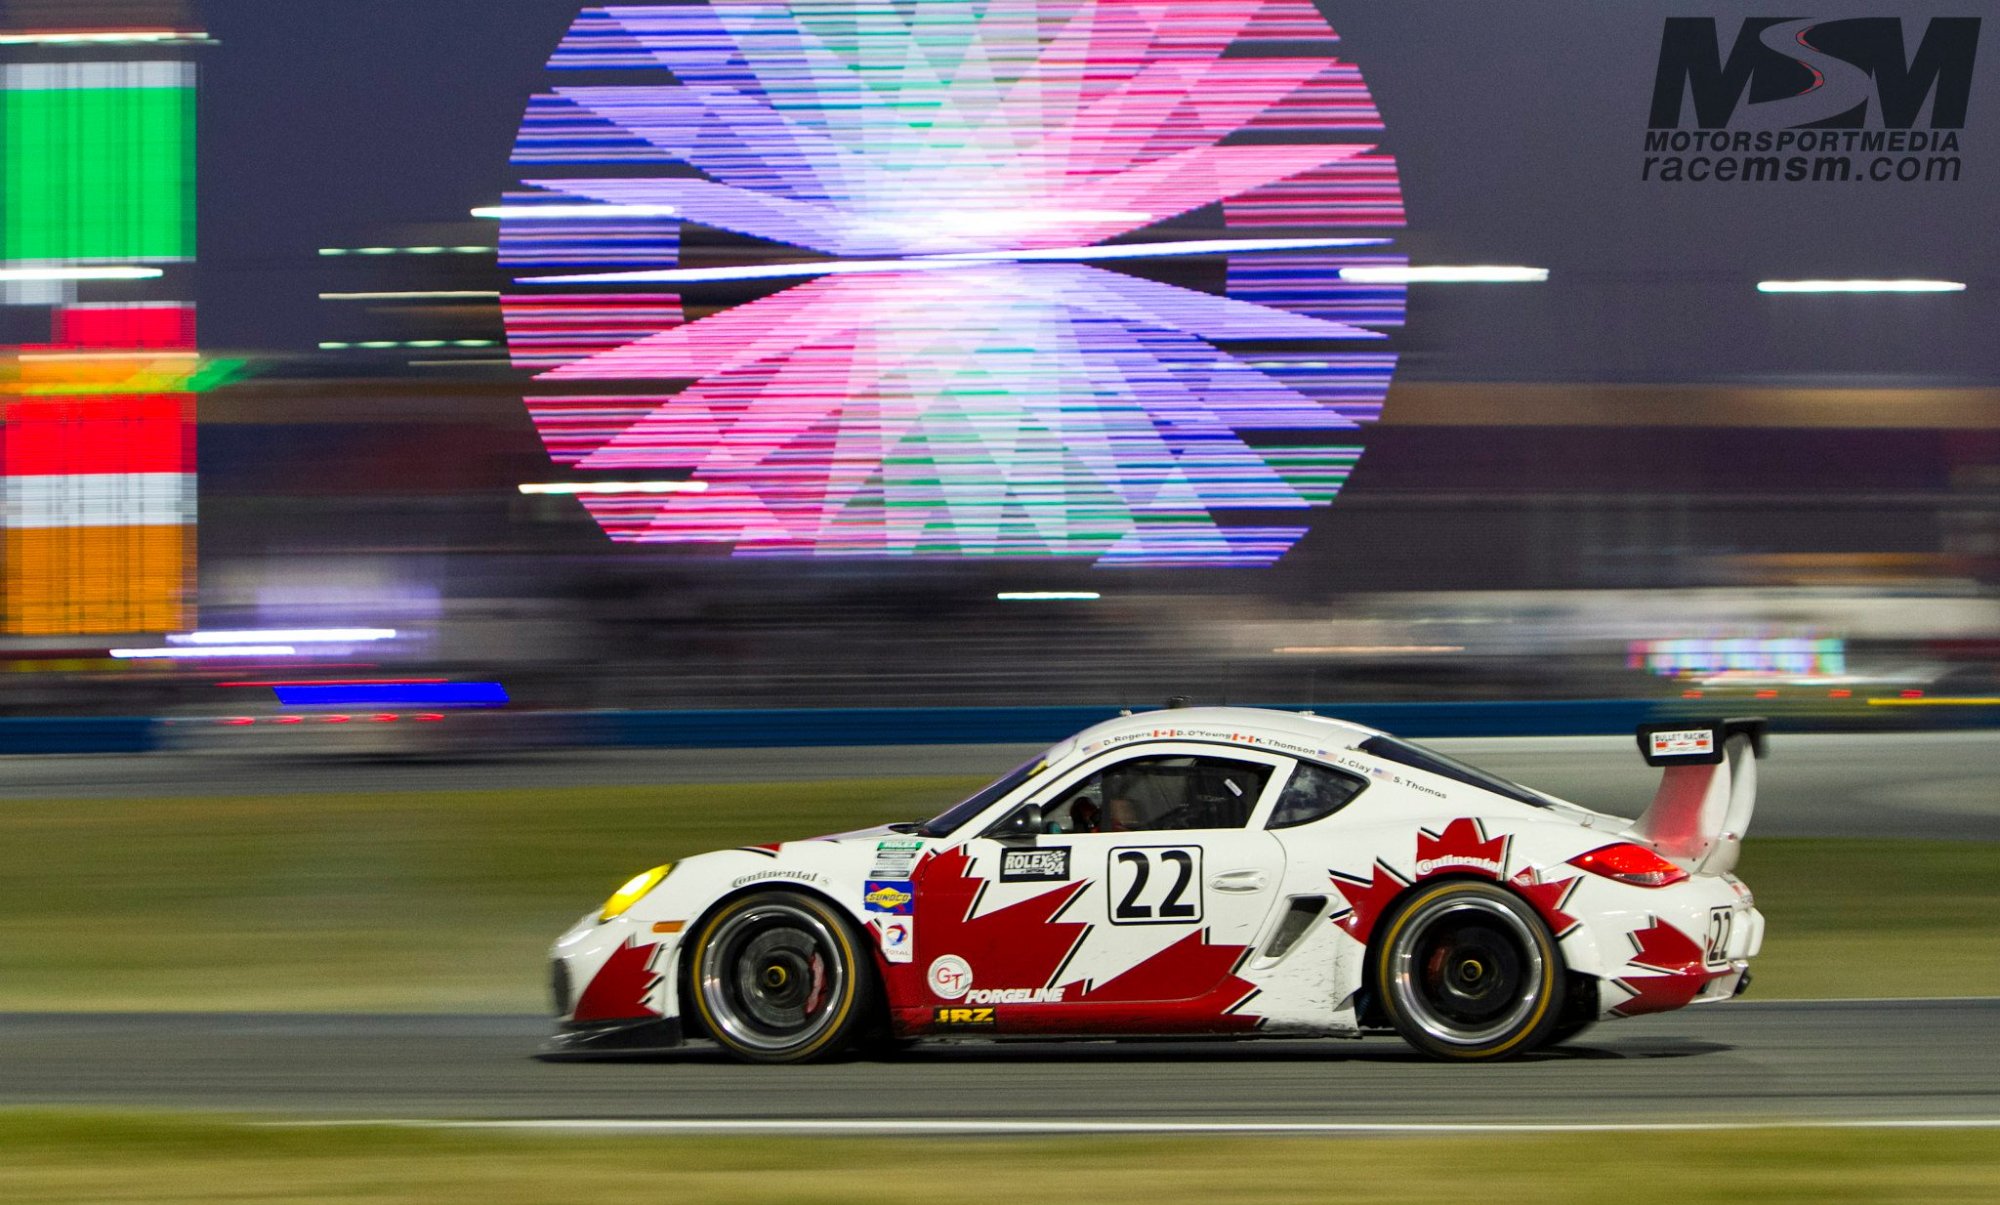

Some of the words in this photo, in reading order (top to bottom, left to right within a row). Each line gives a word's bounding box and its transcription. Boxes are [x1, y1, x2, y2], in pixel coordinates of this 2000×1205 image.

[1655, 733, 1682, 742] BULLET
[1684, 732, 1711, 740] RACING
[1268, 739, 1316, 755] Thomson
[1348, 760, 1371, 773] Clay
[1405, 779, 1447, 799] Thomas
[1005, 854, 1049, 869] ROLEX
[1045, 861, 1065, 875] 24
[1416, 854, 1502, 876] Continental
[732, 870, 818, 888] Continental
[1116, 850, 1195, 918] 22
[869, 893, 910, 902] SUNOCO
[1708, 911, 1731, 961] 22
[886, 948, 911, 956] TOTAL
[936, 967, 963, 990] GT
[964, 987, 1066, 1004] FORGELINE
[935, 1007, 994, 1023] JRZ
